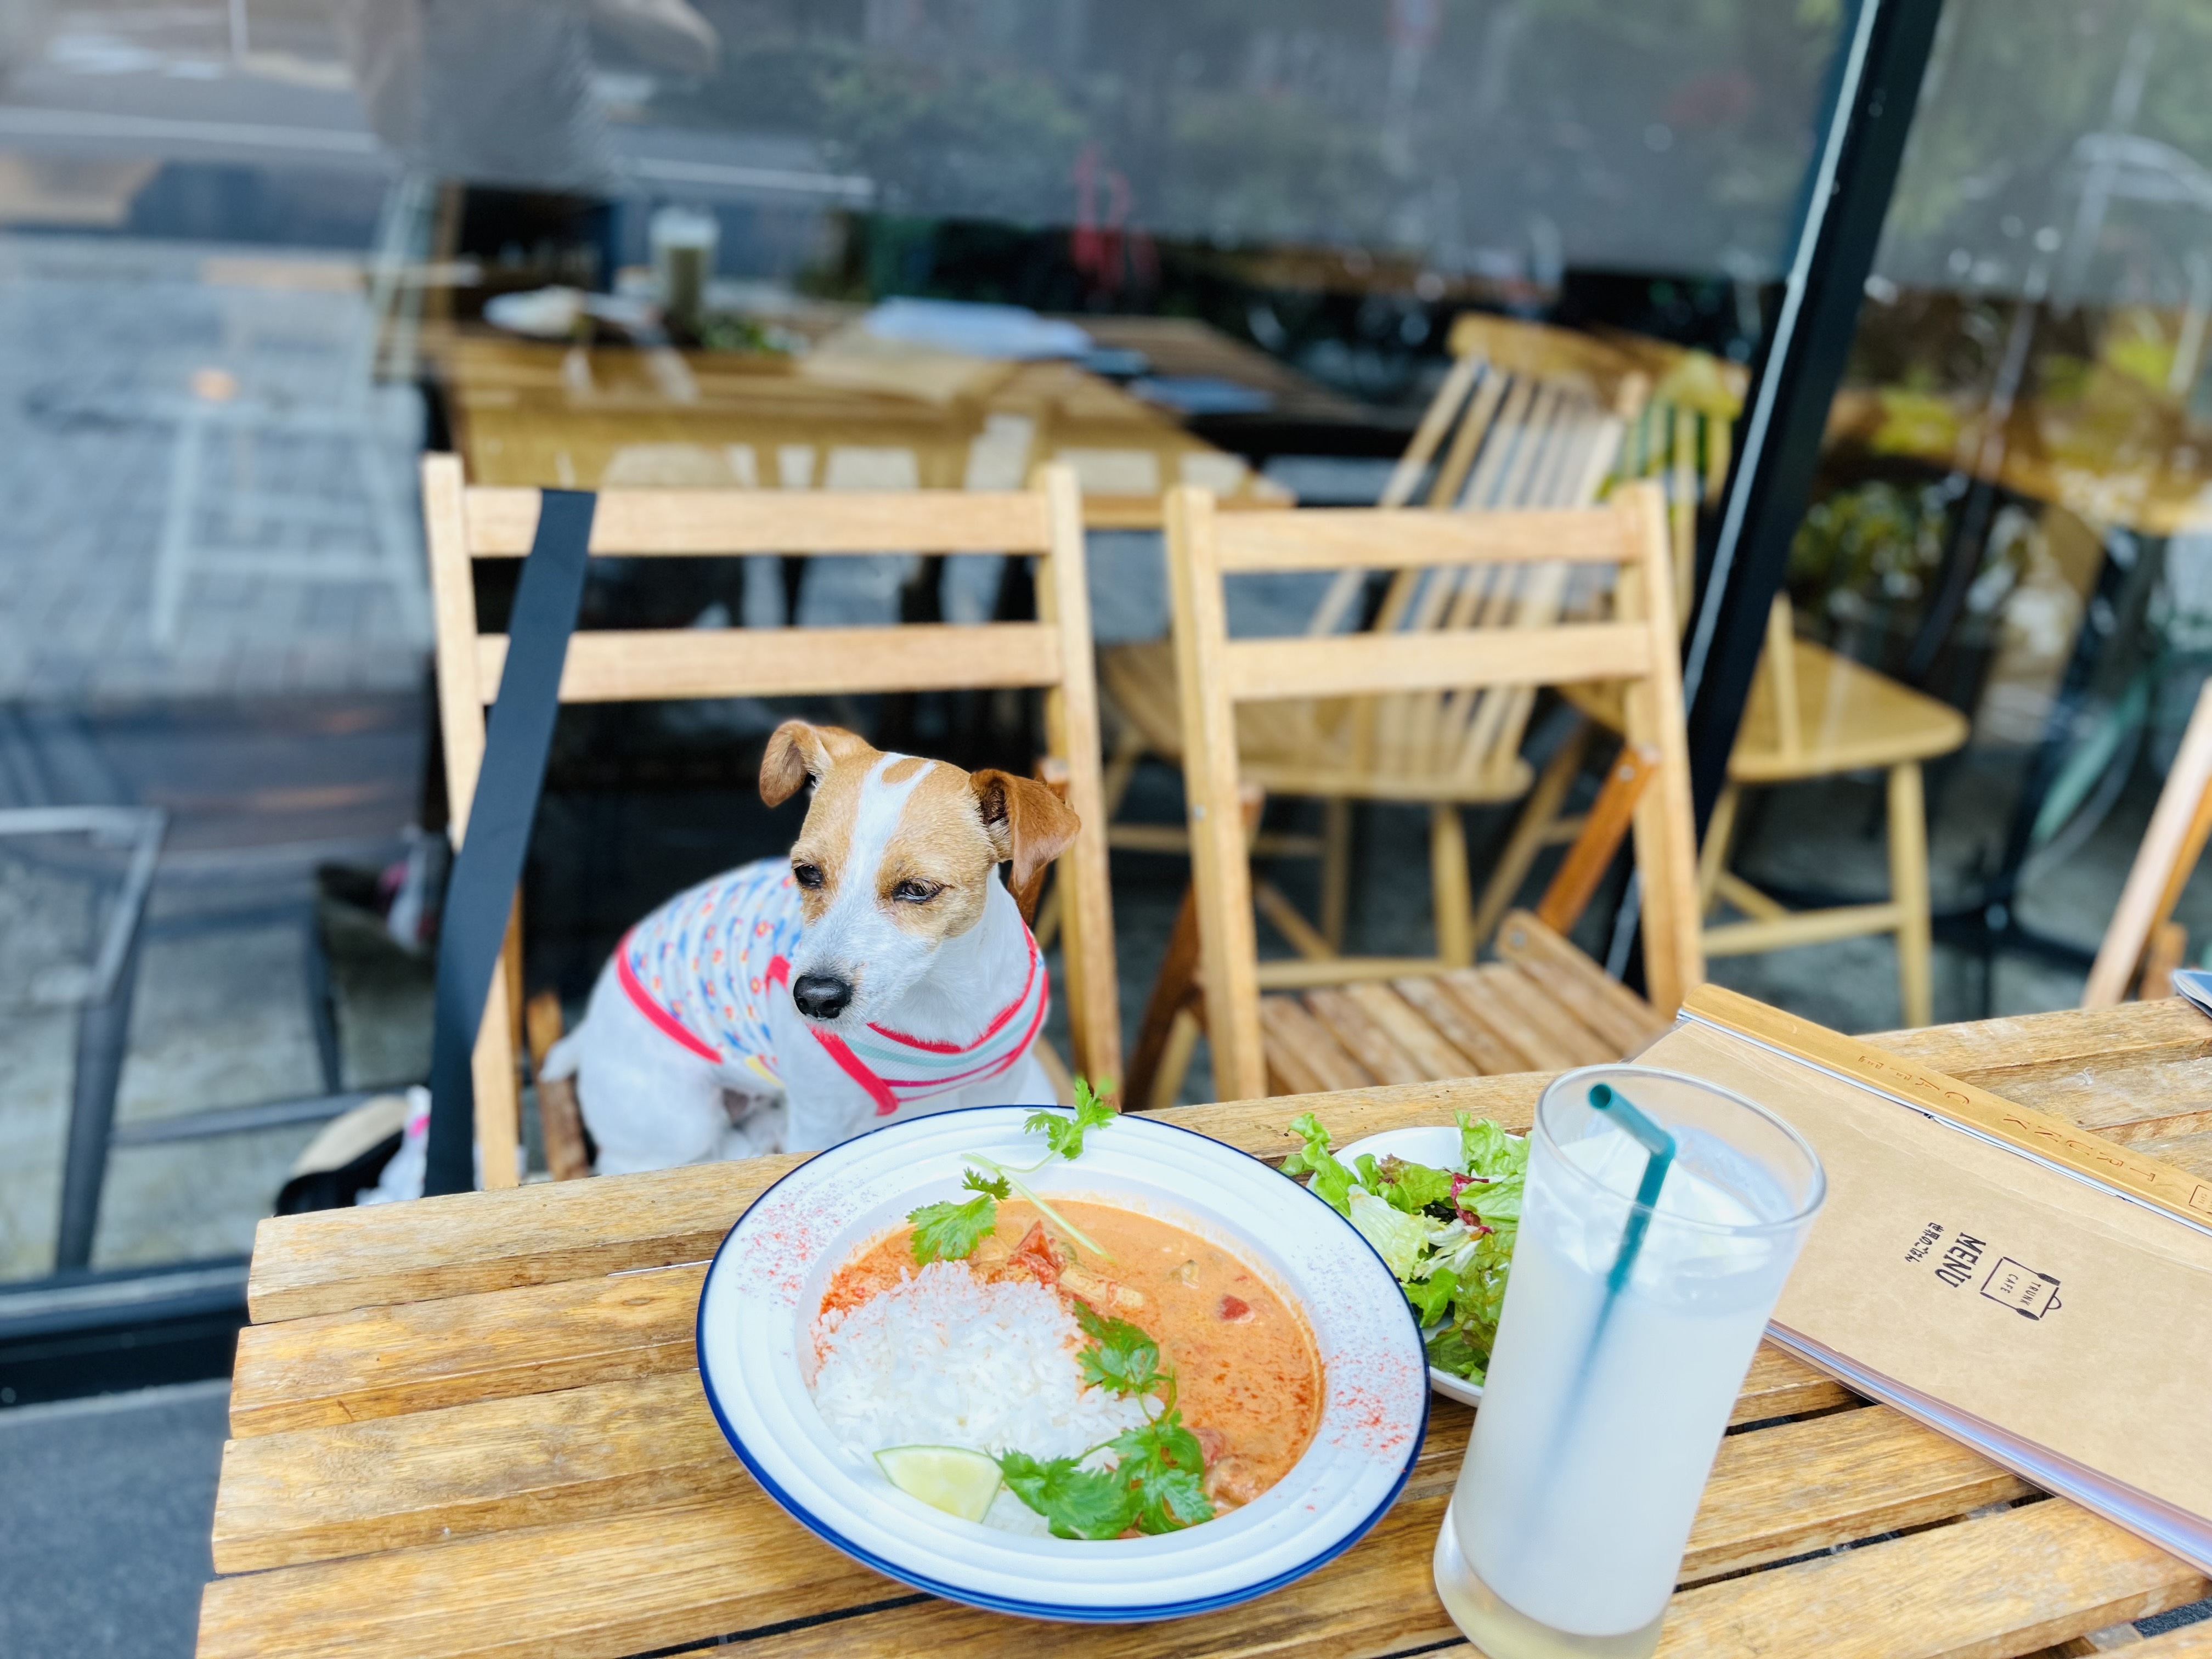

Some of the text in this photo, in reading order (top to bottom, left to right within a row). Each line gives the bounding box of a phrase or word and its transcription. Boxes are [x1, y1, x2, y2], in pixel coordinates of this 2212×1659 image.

[1858, 1056, 2155, 1182] TRUNK CAFE
[1904, 1222, 1944, 1262] 世界のごはん
[1934, 1232, 1986, 1288] MENU
[2000, 1274, 2019, 1294] CAFE
[2019, 1281, 2041, 1306] TRUNK
